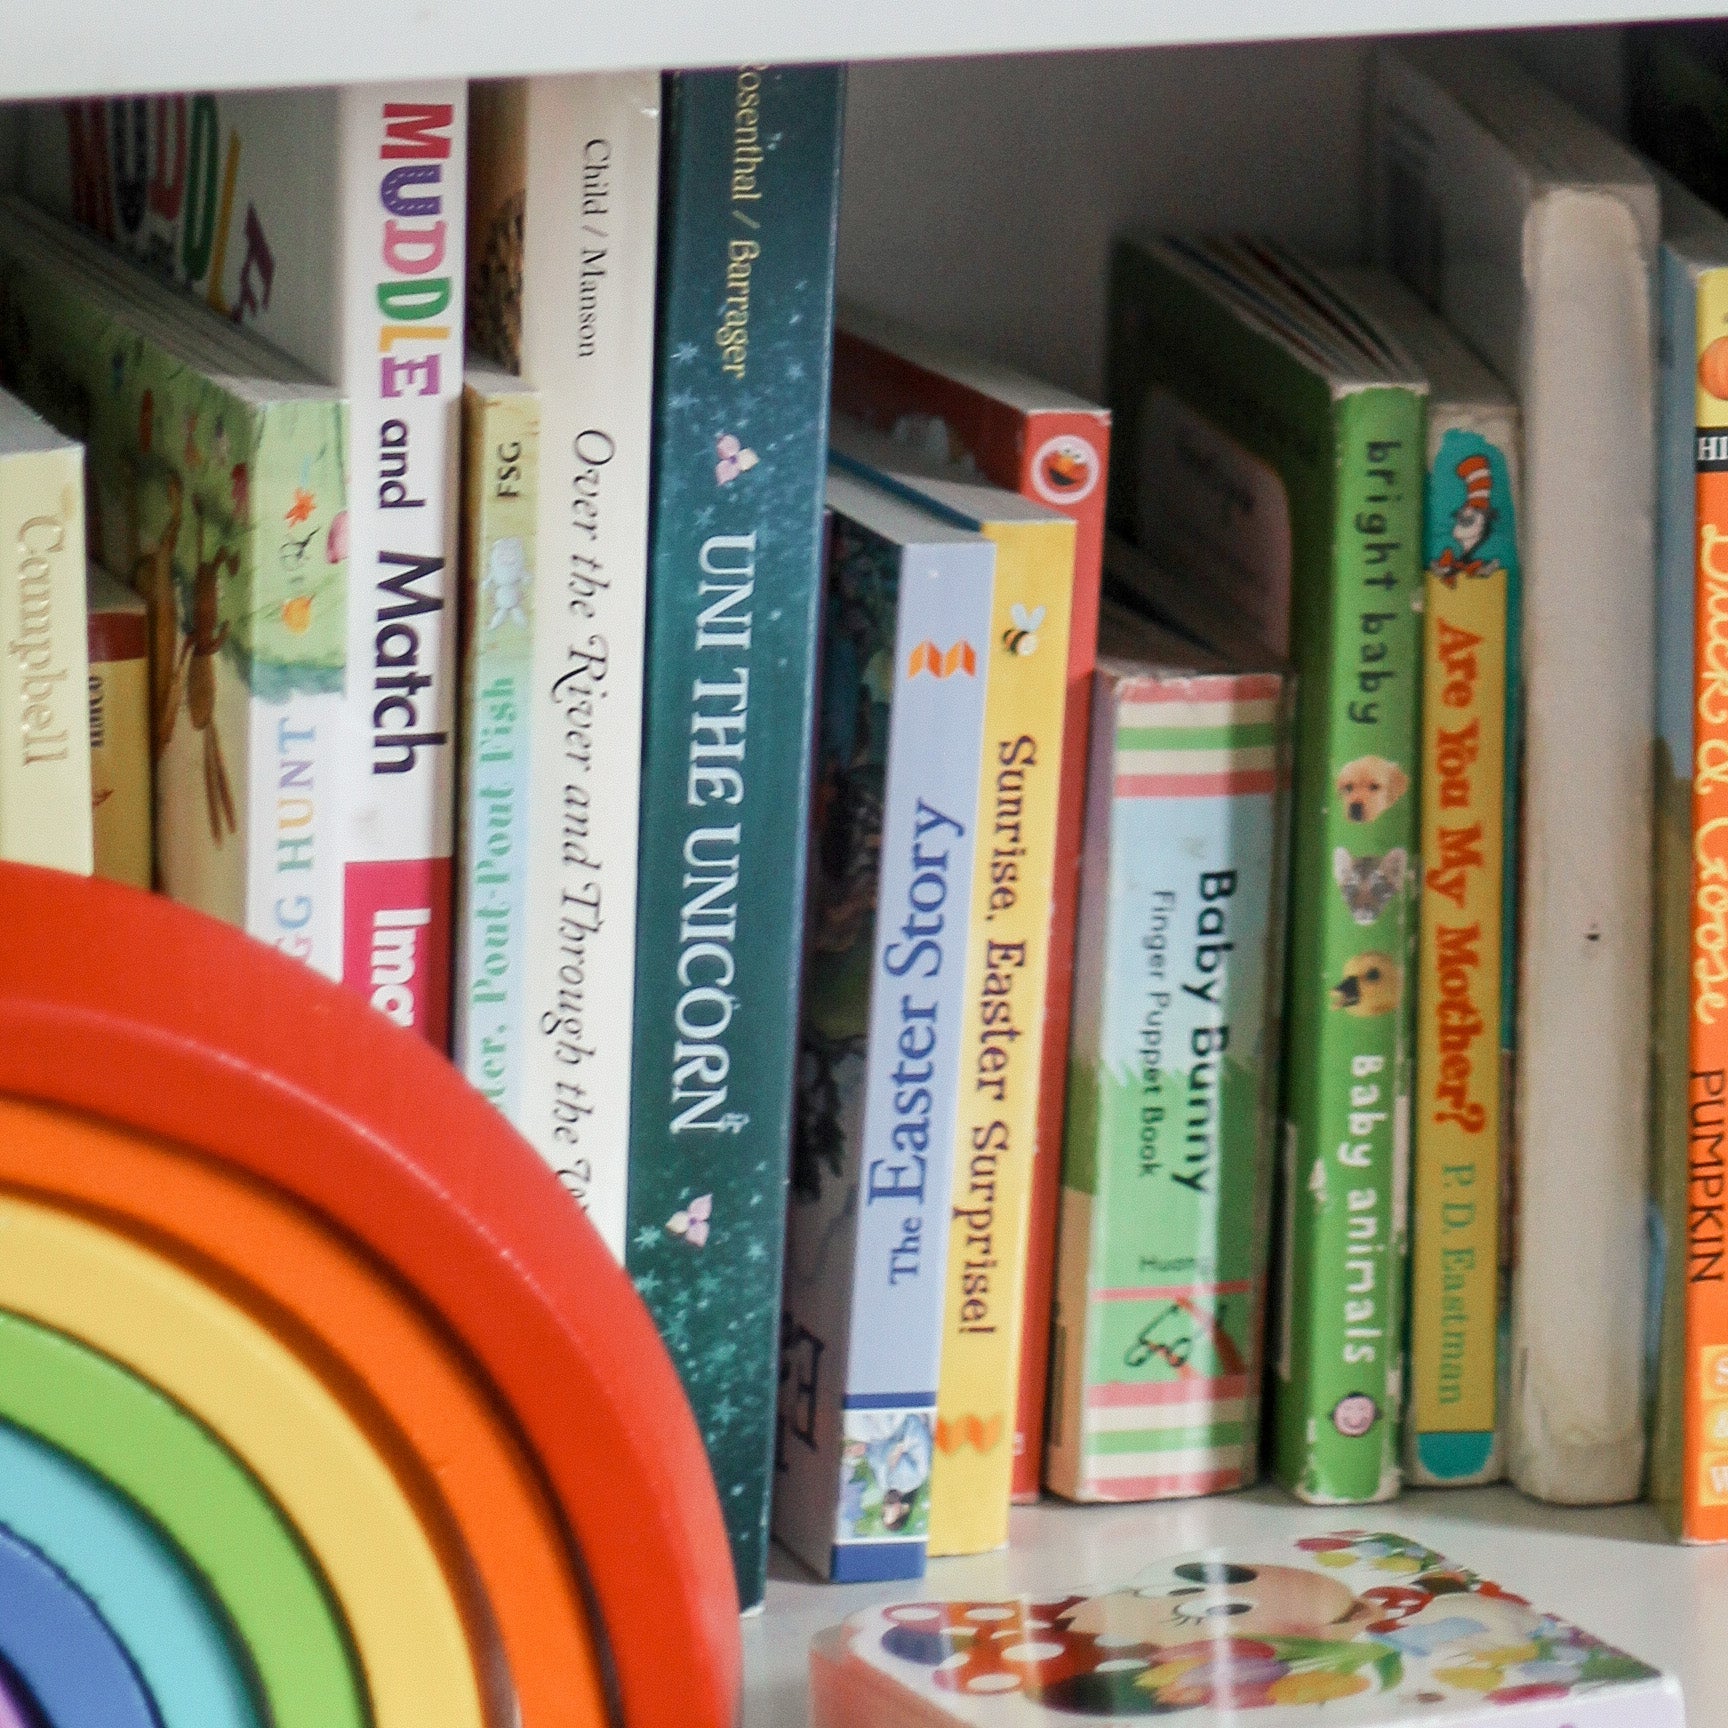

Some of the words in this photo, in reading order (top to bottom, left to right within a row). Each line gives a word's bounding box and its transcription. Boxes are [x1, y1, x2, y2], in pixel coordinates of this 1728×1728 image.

[582, 138, 611, 215] Child
[730, 65, 767, 201] osenthal
[374, 102, 457, 399] MUDDLE
[582, 225, 607, 240] /
[732, 209, 761, 229] /
[577, 248, 607, 358] Manson
[716, 240, 760, 381] Barrager
[378, 418, 428, 512] and
[496, 442, 521, 499] FSG
[568, 429, 616, 540] Over
[1354, 440, 1401, 591] bright
[10, 515, 69, 769] Campbell
[567, 556, 608, 618] the
[698, 530, 756, 650] UNI
[370, 550, 448, 777] Match
[476, 676, 517, 764] Fish
[552, 633, 609, 767] River
[1347, 612, 1398, 725] baby
[1437, 618, 1486, 709] Are
[276, 716, 315, 874] HUNT
[688, 667, 749, 806] THE
[1436, 716, 1482, 810] You
[472, 782, 513, 1005] Pout-Pout
[560, 784, 604, 870] and
[883, 797, 965, 978] Story
[987, 734, 1036, 922] Sunrise,
[1425, 820, 1485, 910] My
[540, 883, 605, 1067] Through
[669, 823, 742, 1136] UNICORN
[1144, 891, 1176, 978] Finger
[1182, 869, 1237, 1003] Baby
[977, 939, 1027, 1102] Easter
[1138, 991, 1171, 1093] Puppet
[1432, 922, 1488, 1137] Mother?
[553, 1081, 594, 1144] the
[867, 994, 938, 1205] Easter
[1141, 1106, 1167, 1176] Book
[1171, 1026, 1230, 1193] Bunny
[953, 1120, 1010, 1335] Surprise!
[1690, 1068, 1725, 1283] PUMPKIN
[888, 1216, 921, 1286] The
[1343, 1187, 1385, 1364] animals
[1438, 1247, 1477, 1405] Eastman
